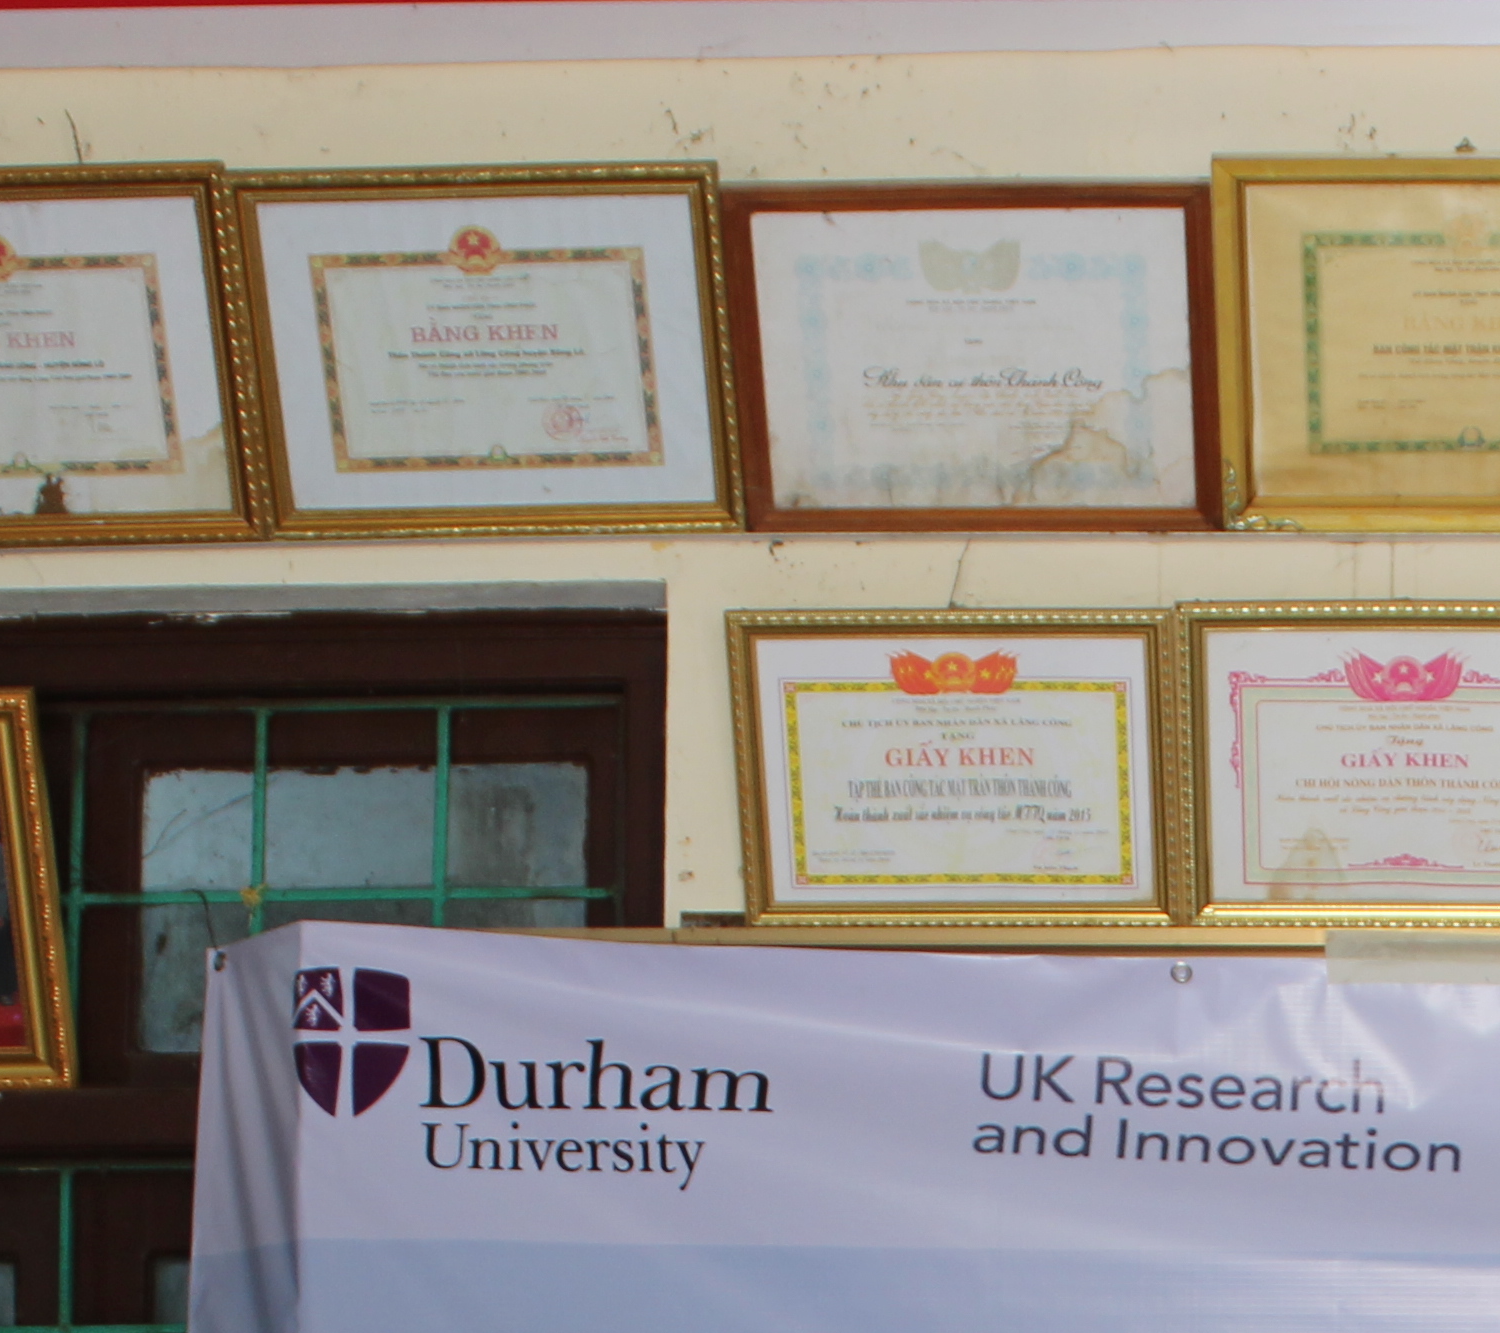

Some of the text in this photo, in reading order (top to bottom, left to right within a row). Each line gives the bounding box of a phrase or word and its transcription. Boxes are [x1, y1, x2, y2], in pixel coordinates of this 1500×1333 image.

[6, 331, 76, 349] KHEN
[410, 317, 558, 342] BẰNG KHEN
[884, 740, 1035, 767] GIẤY KHEN
[1340, 749, 1469, 769] GIẤY KHEN
[418, 1035, 774, 1114] Durham
[978, 1051, 1388, 1116] UK Research
[421, 1122, 706, 1191] University
[972, 1115, 1463, 1174] and Innovation
